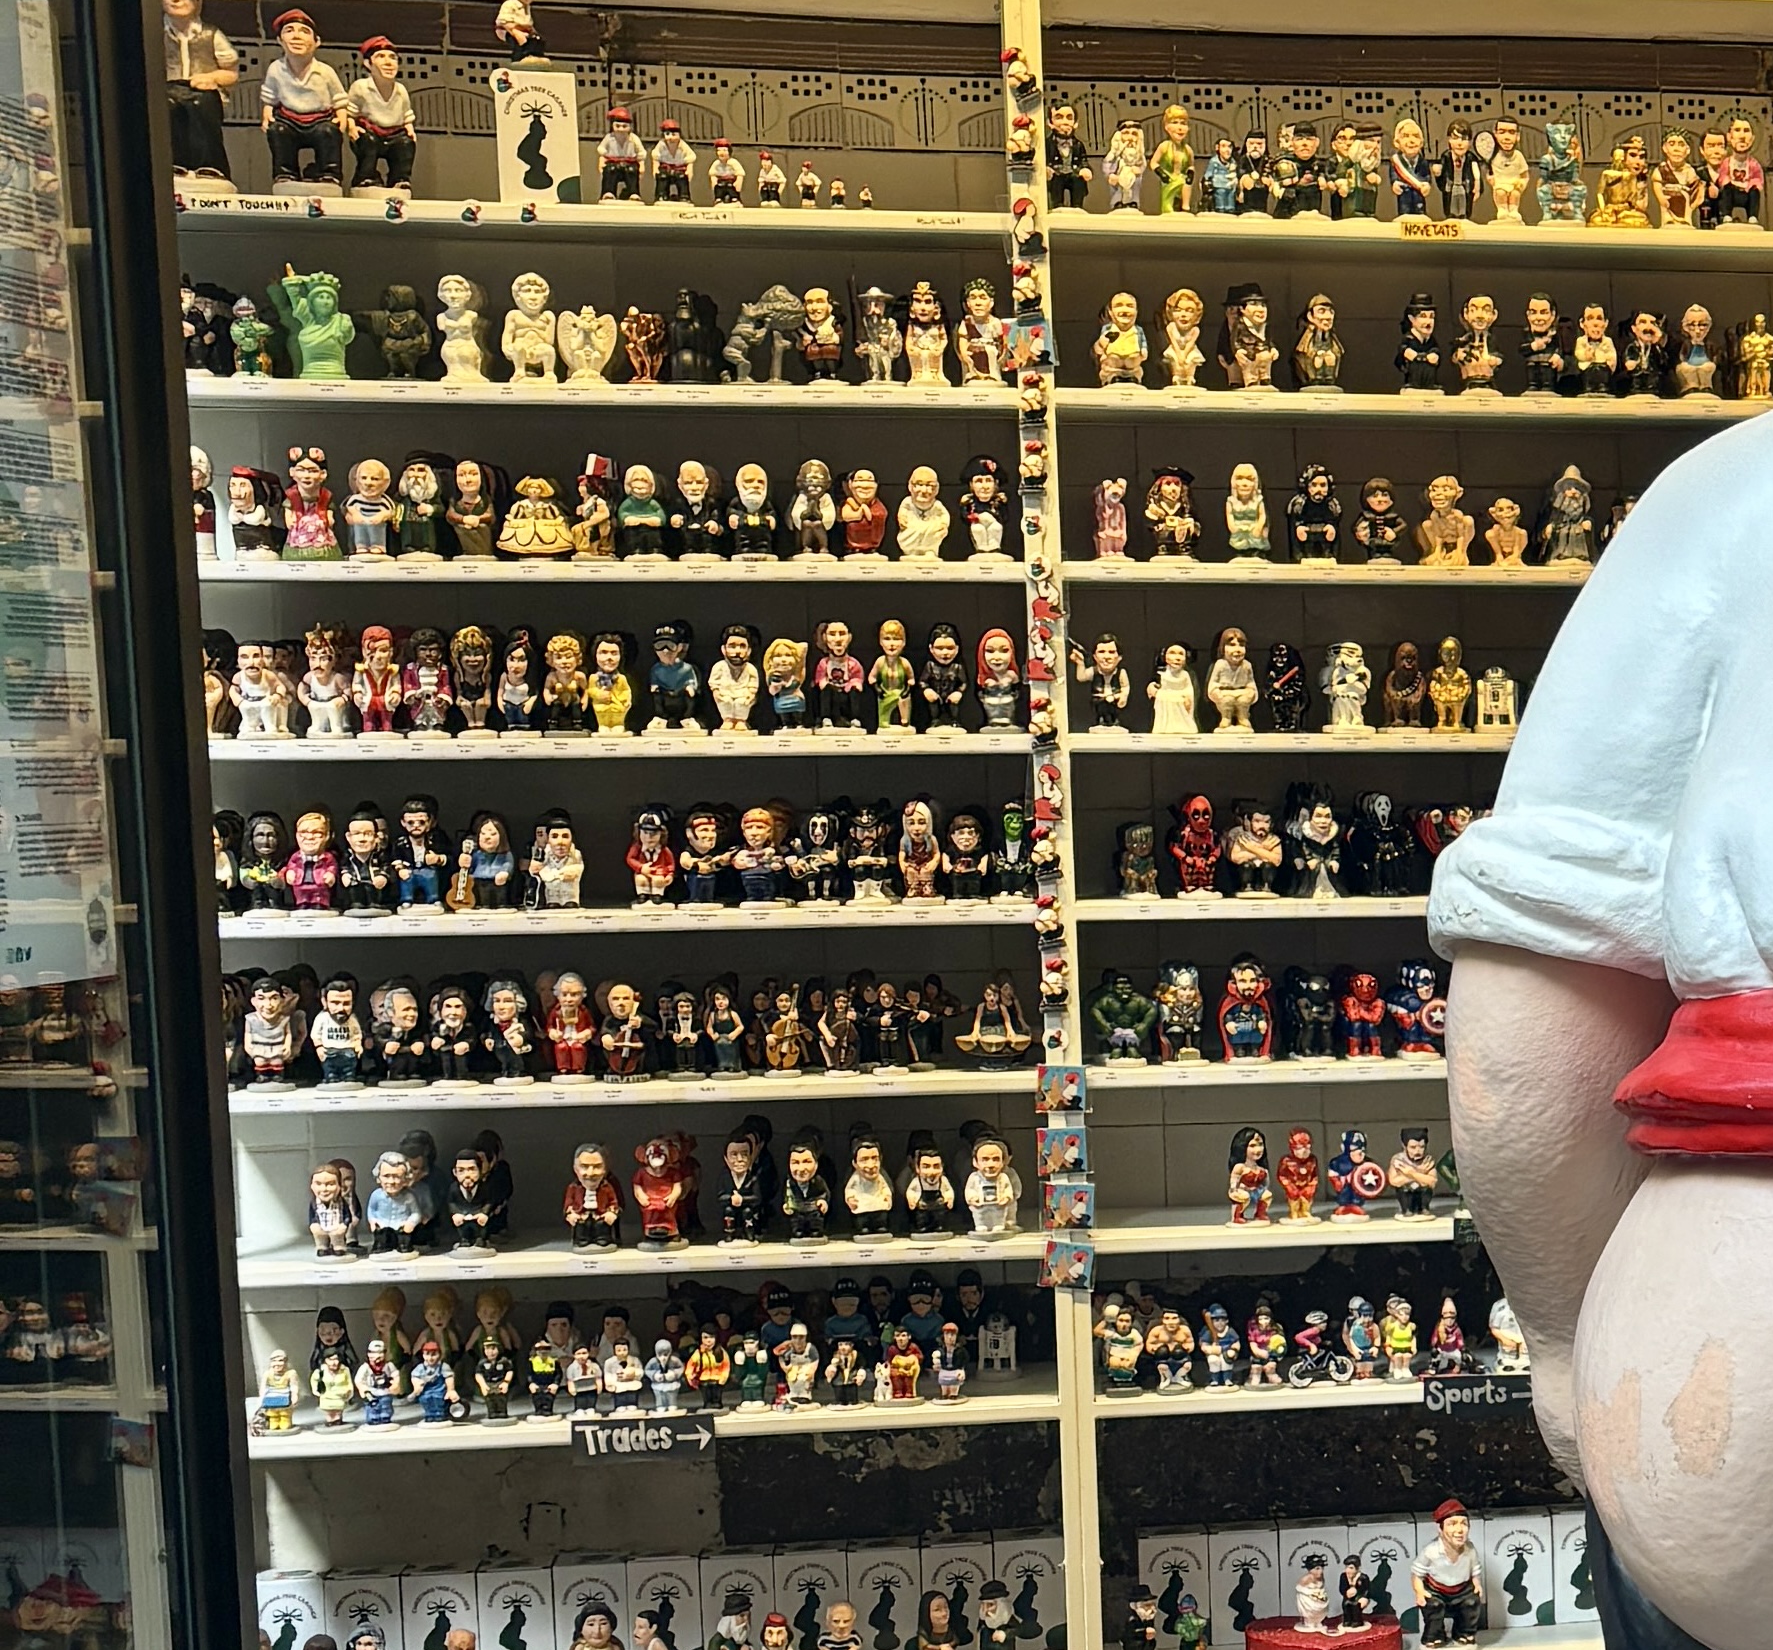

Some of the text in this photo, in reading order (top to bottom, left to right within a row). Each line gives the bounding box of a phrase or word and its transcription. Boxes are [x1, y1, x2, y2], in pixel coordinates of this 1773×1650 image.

[1404, 224, 1459, 237] NOVETATS
[1426, 1379, 1508, 1414] Sports
[574, 1420, 673, 1456] Trades
